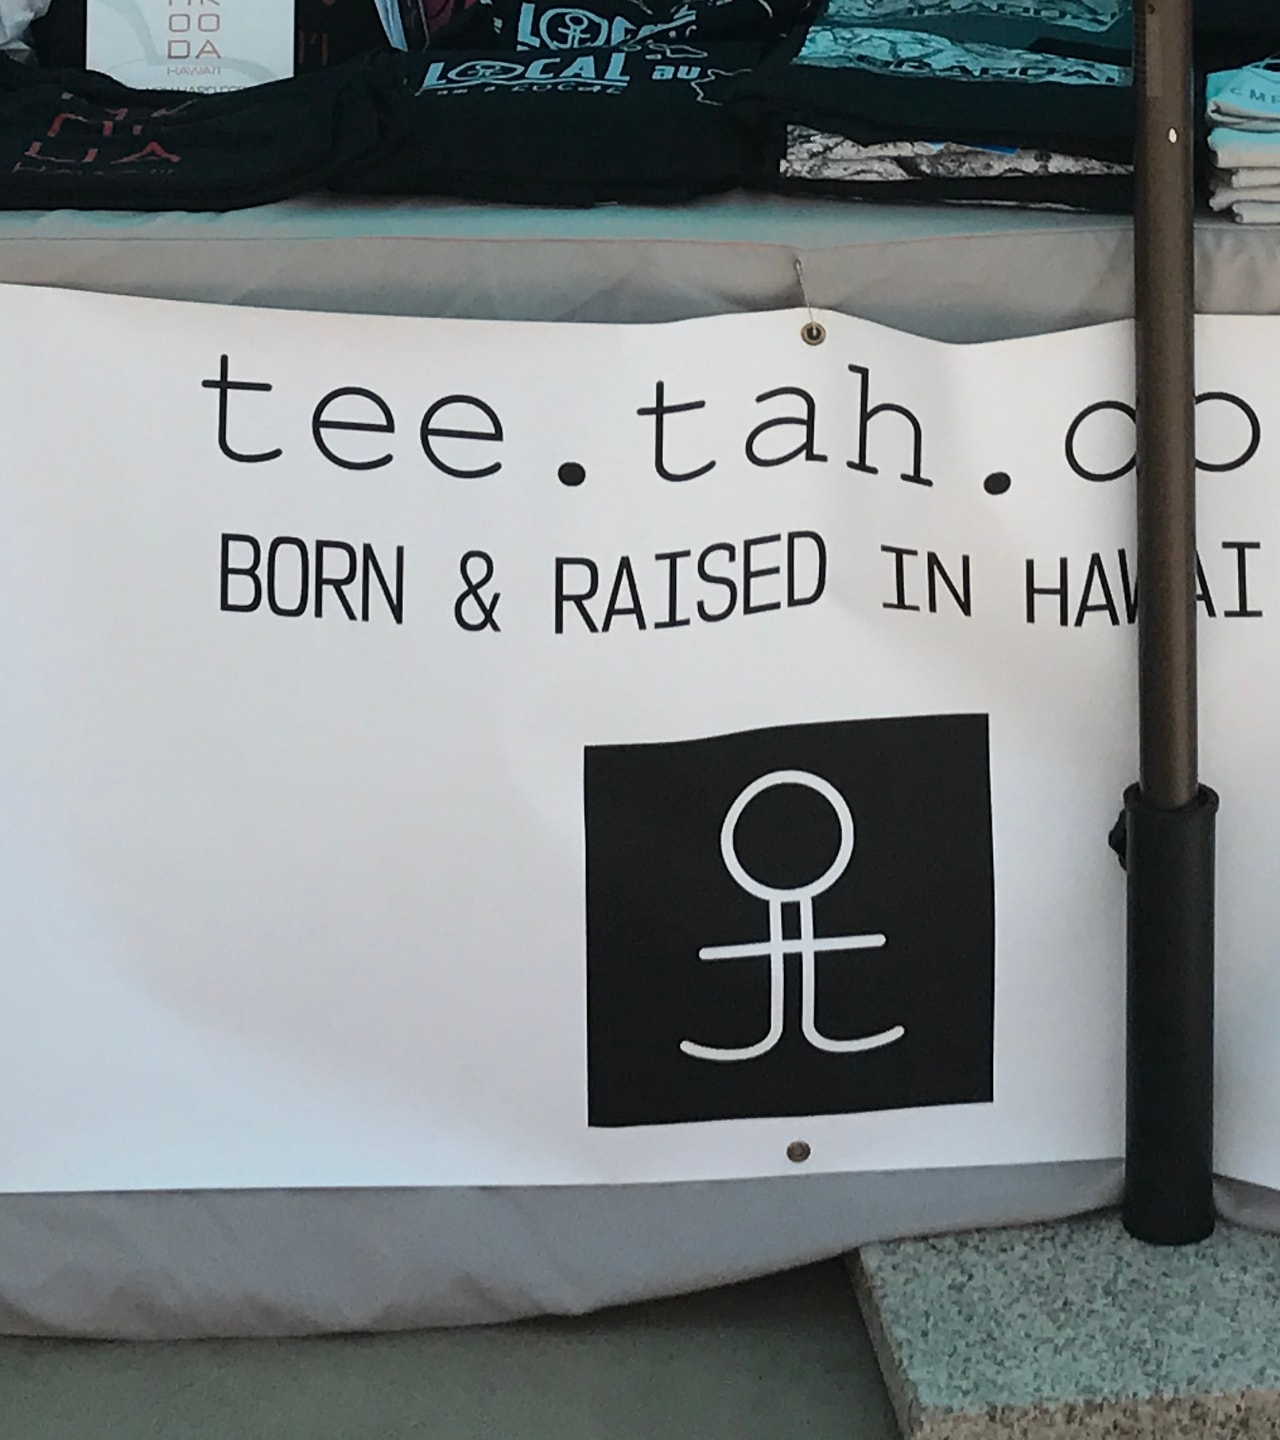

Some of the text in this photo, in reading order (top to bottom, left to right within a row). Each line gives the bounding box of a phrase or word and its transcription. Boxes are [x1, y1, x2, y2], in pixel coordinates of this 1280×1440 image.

[422, 52, 631, 89] LOCAL
[220, 532, 405, 626] BORN
[453, 549, 502, 633] &
[554, 529, 828, 635] RAISED
[880, 543, 973, 618] IN
